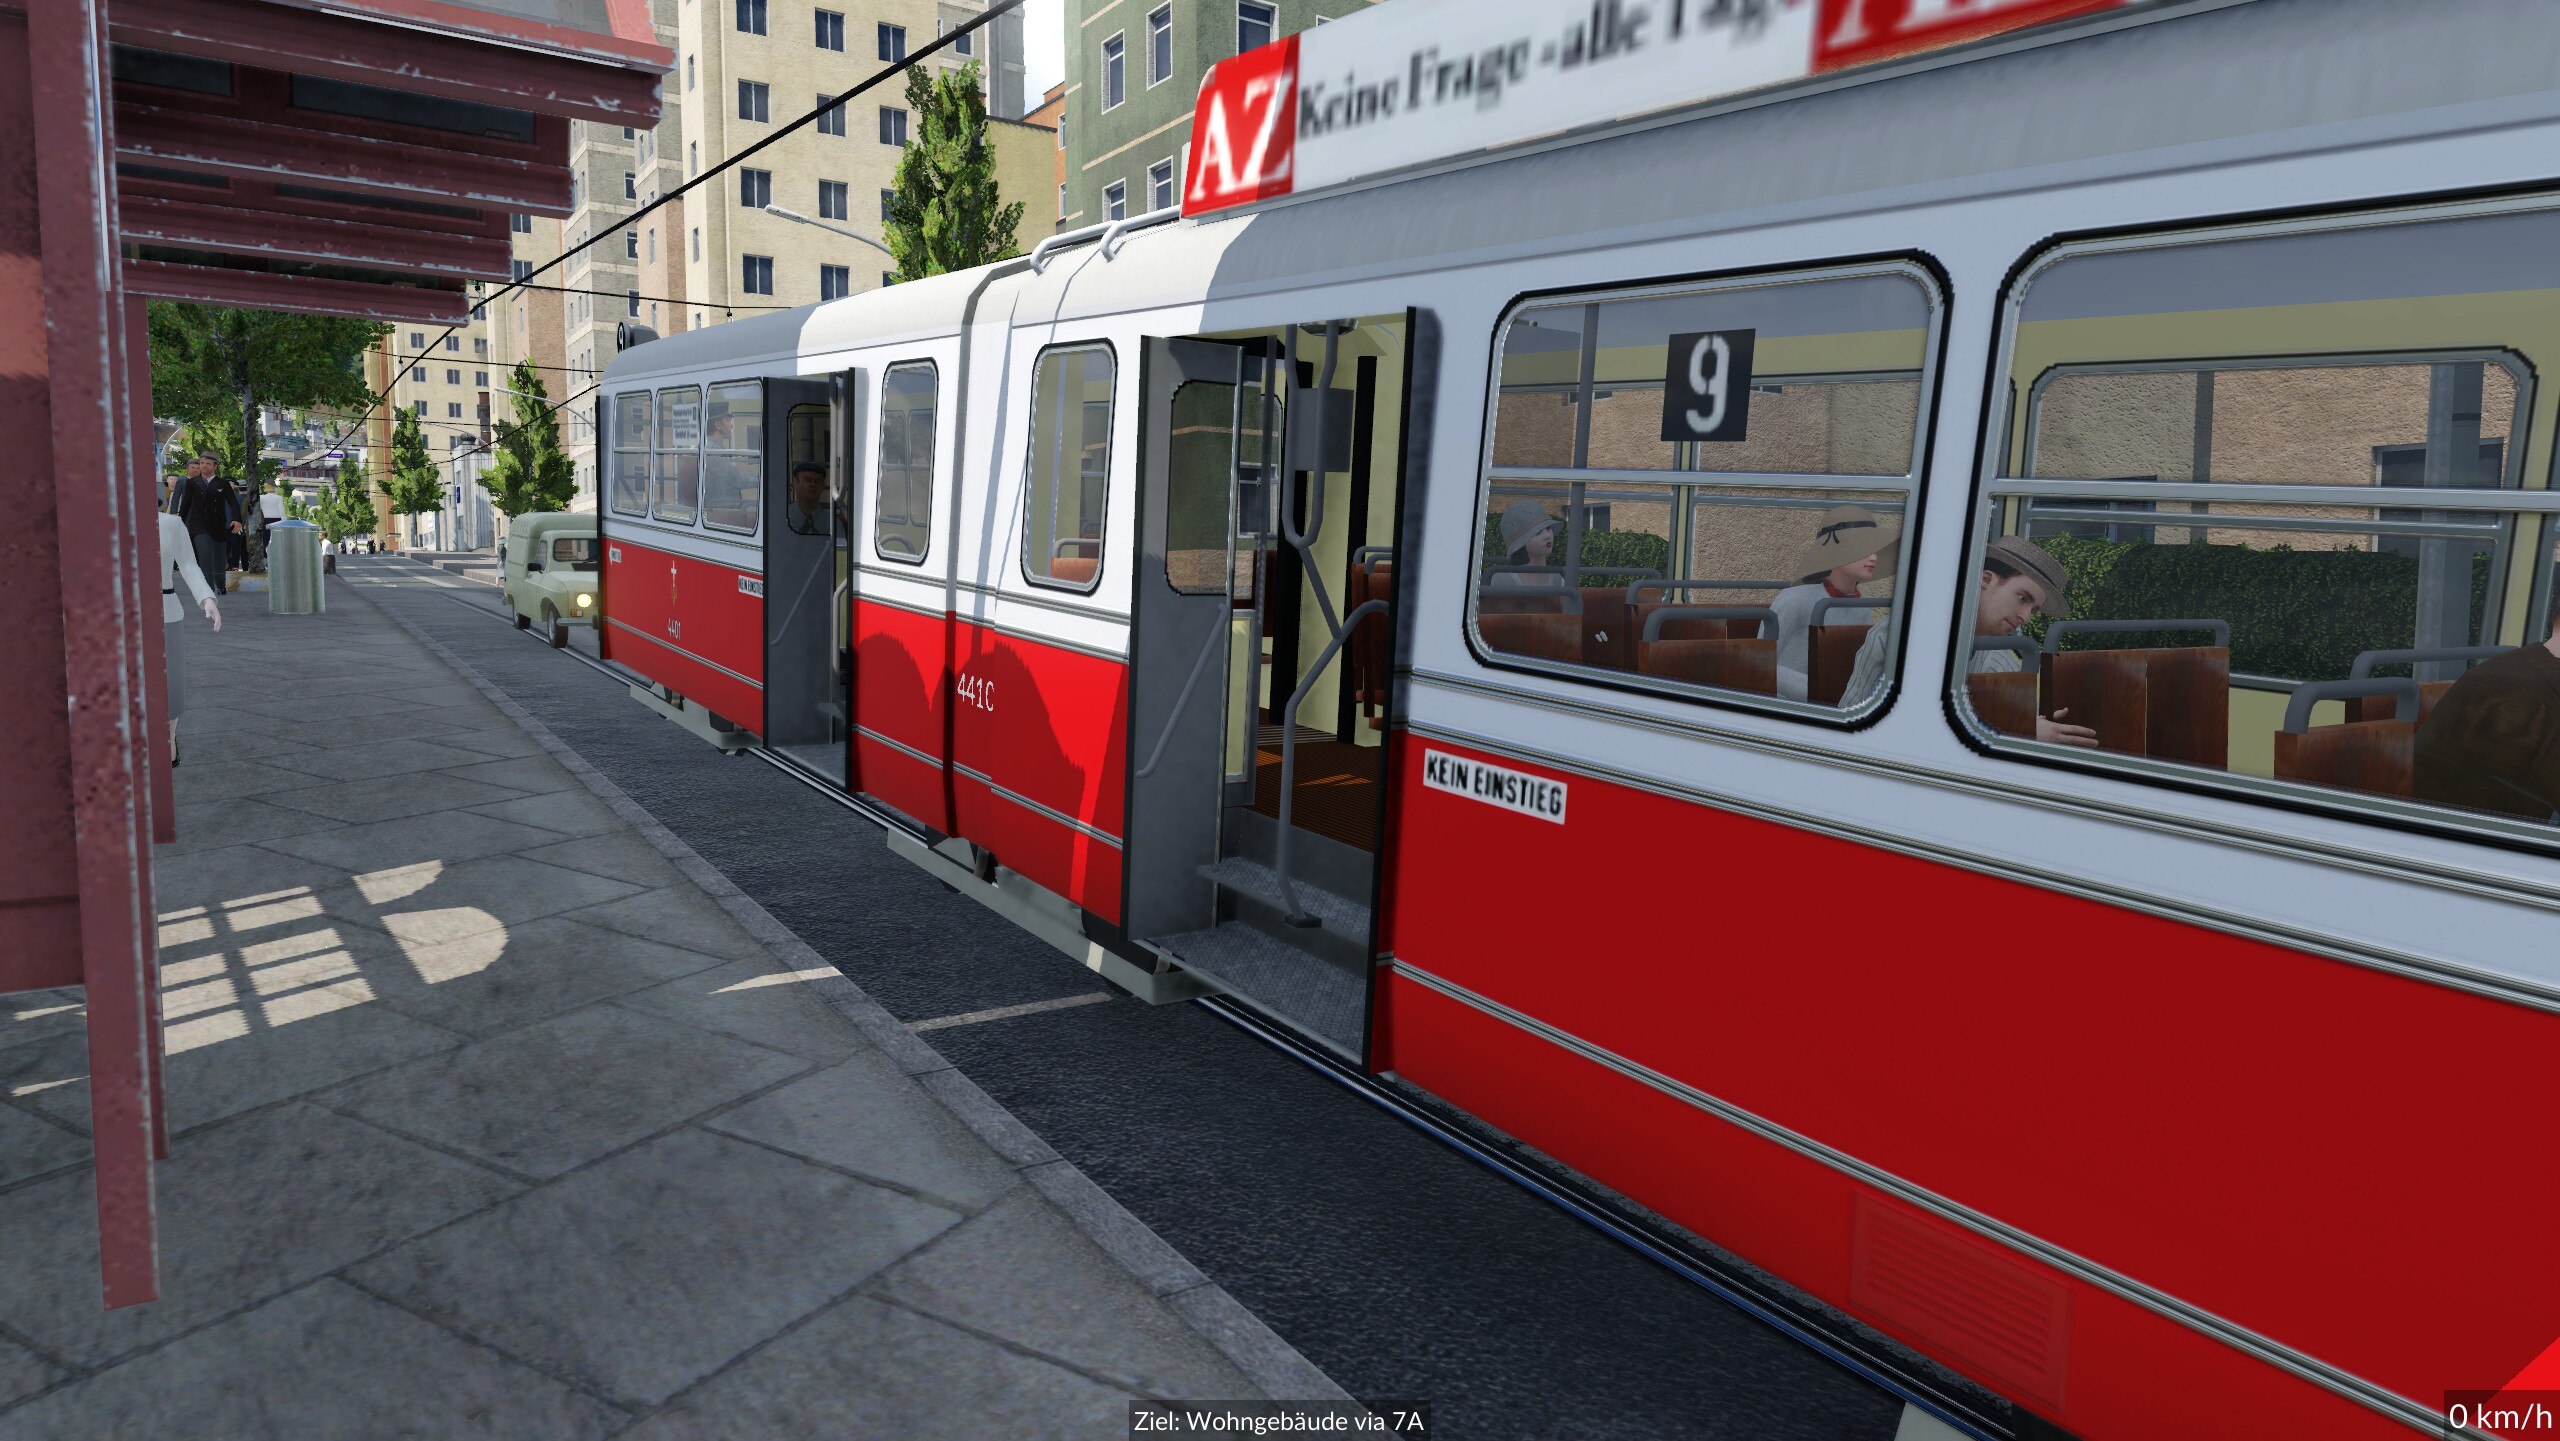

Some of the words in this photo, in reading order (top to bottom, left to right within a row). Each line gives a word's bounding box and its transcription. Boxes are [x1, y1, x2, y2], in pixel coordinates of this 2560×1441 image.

[1188, 67, 1296, 202] AZ
[1405, 34, 1531, 112] Frage
[1686, 334, 1730, 433] 9
[1427, 754, 1468, 790] KEIN
[1474, 766, 1562, 816] EINSTIEG
